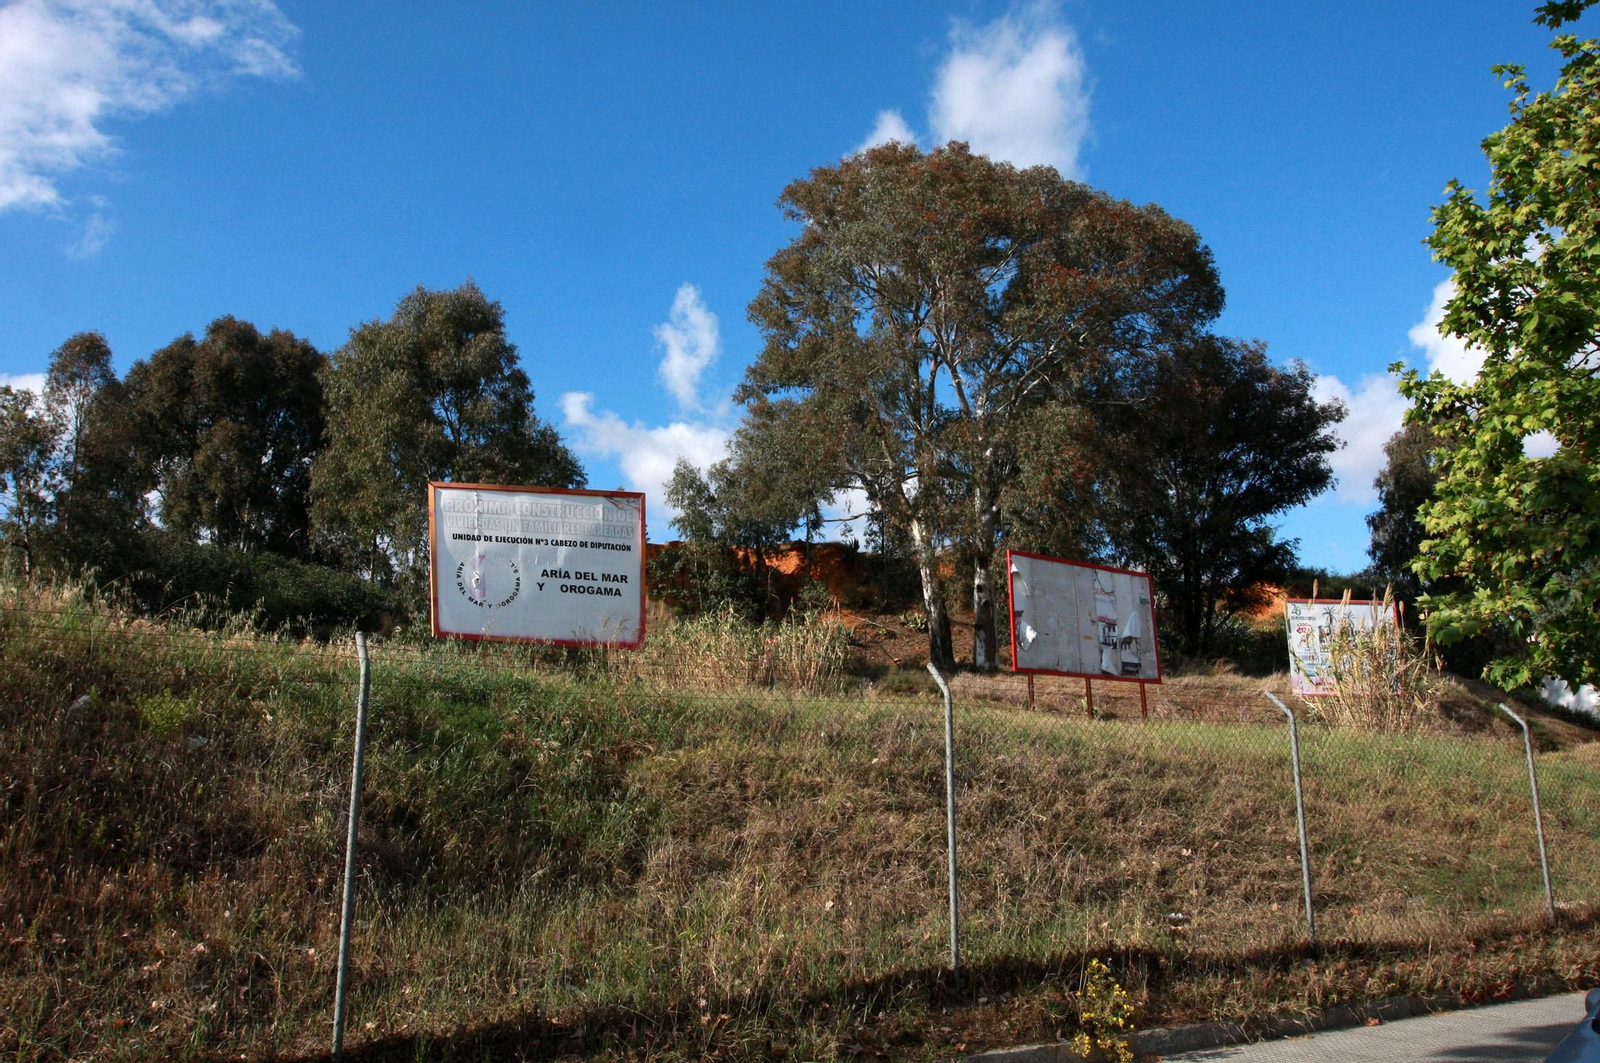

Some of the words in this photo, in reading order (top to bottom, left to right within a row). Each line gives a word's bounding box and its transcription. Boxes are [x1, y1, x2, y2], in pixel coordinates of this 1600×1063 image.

[445, 515, 503, 531] VIVIEDAS
[583, 522, 635, 540] PAREADAS
[452, 533, 481, 542] UNIDAD
[484, 535, 493, 543] DE
[495, 536, 533, 545] EJECUCIÓN
[550, 539, 578, 548] CABEZO
[579, 541, 589, 549] DE
[590, 541, 632, 552] DIPUTACIÓN
[541, 568, 571, 580] ARÍA
[574, 571, 598, 582] DEL
[601, 573, 629, 584] MAR
[457, 582, 467, 596] DEL
[468, 596, 484, 608] MAR
[536, 582, 545, 591] Y
[560, 584, 622, 597] OROGAMA
[1290, 603, 1302, 616] 26
